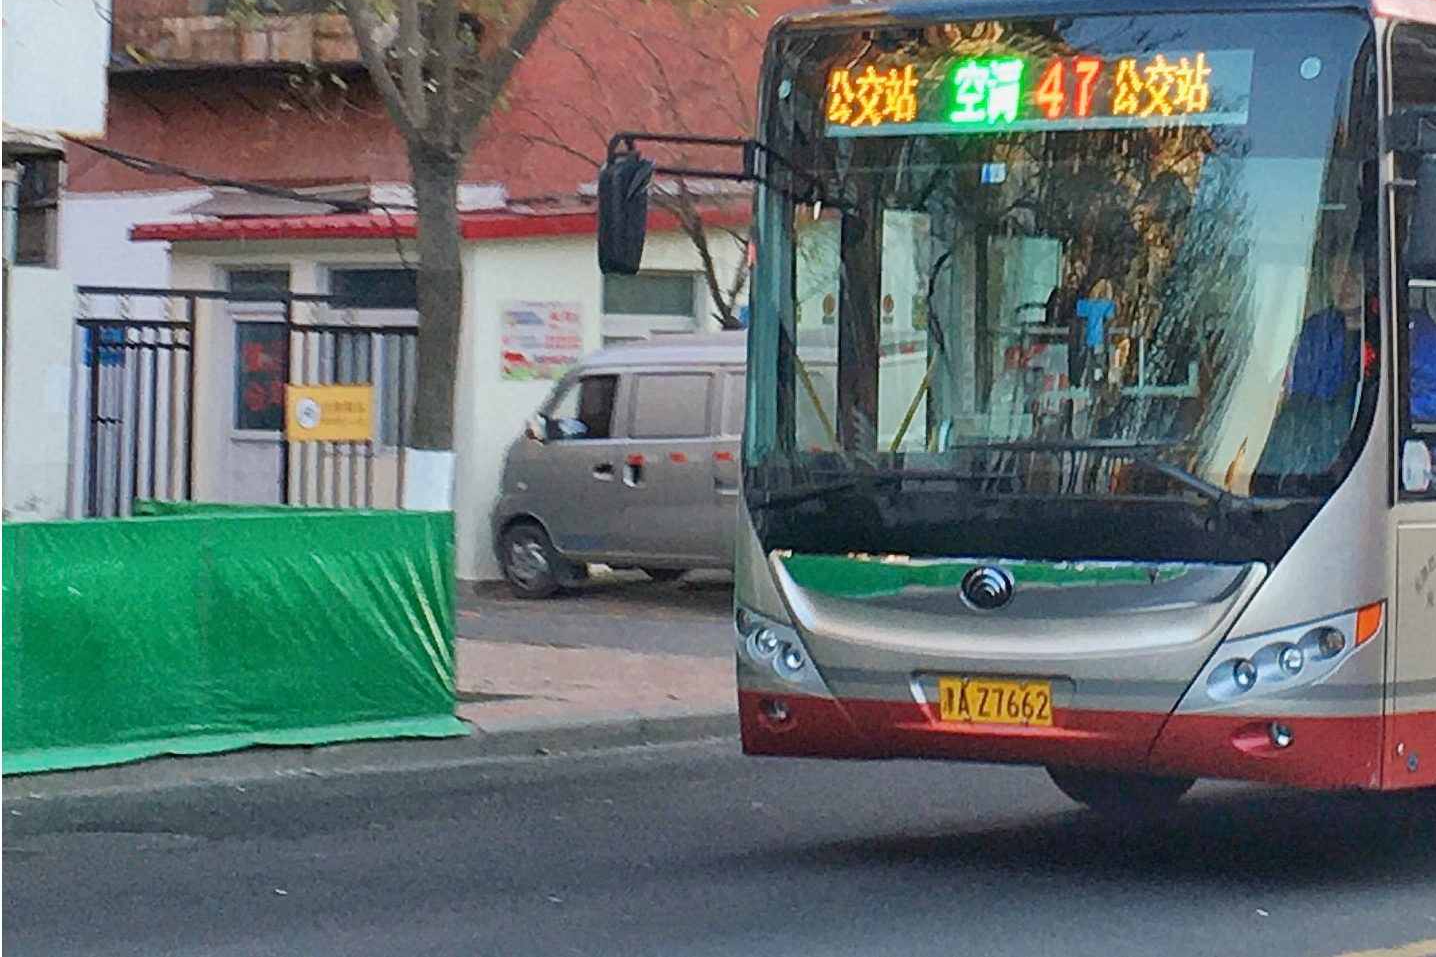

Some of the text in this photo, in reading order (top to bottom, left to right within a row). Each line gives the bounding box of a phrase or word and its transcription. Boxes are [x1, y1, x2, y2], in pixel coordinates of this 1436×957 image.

[827, 63, 918, 127] 公交站
[1036, 57, 1100, 119] 47
[1113, 52, 1211, 117] 公交站
